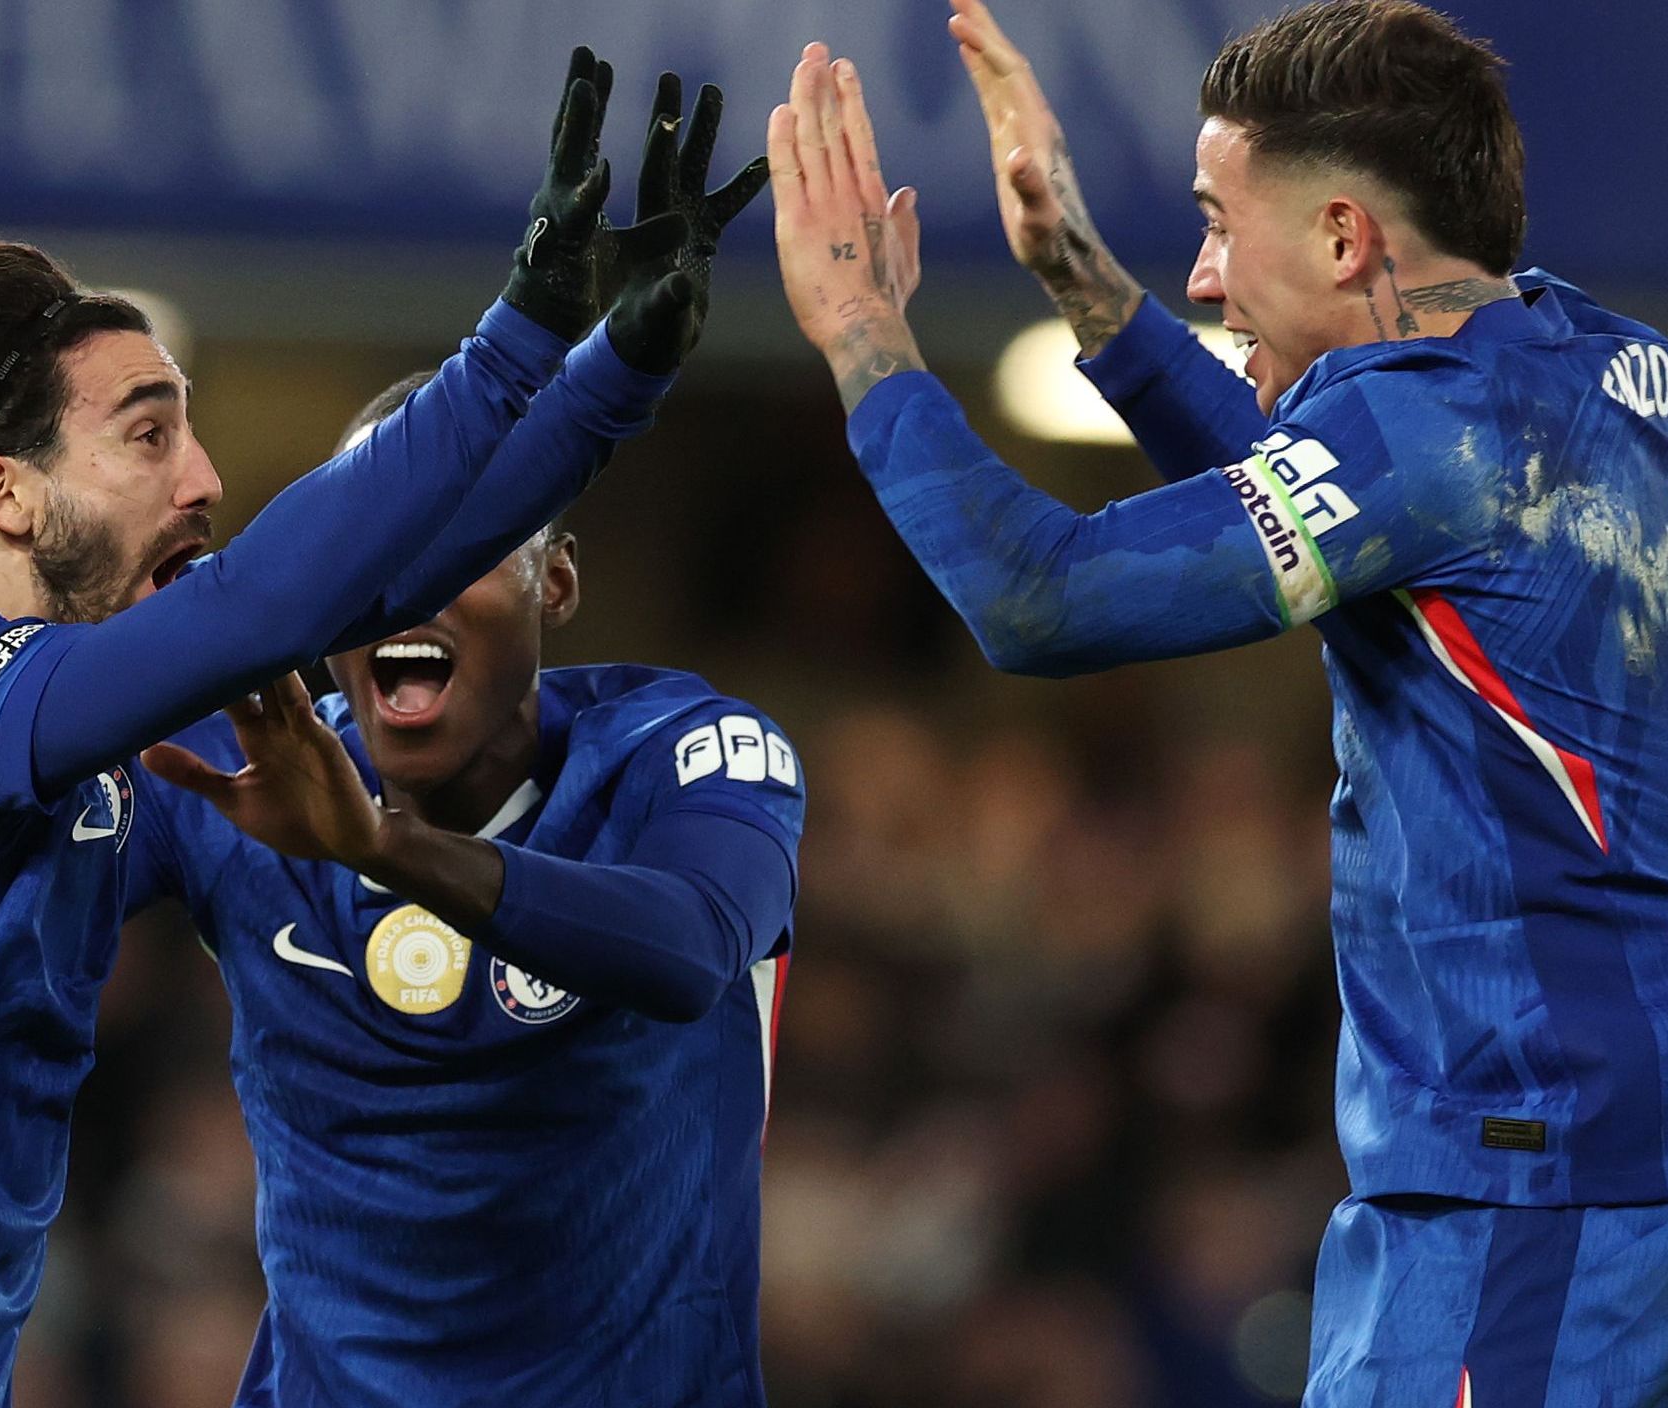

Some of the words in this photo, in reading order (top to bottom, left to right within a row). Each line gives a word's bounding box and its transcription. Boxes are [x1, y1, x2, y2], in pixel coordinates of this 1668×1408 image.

[1221, 461, 1300, 573] aptain
[376, 924, 403, 973] WORLD
[404, 914, 467, 970] CHAMPIONS
[399, 987, 441, 1005] FIFA
